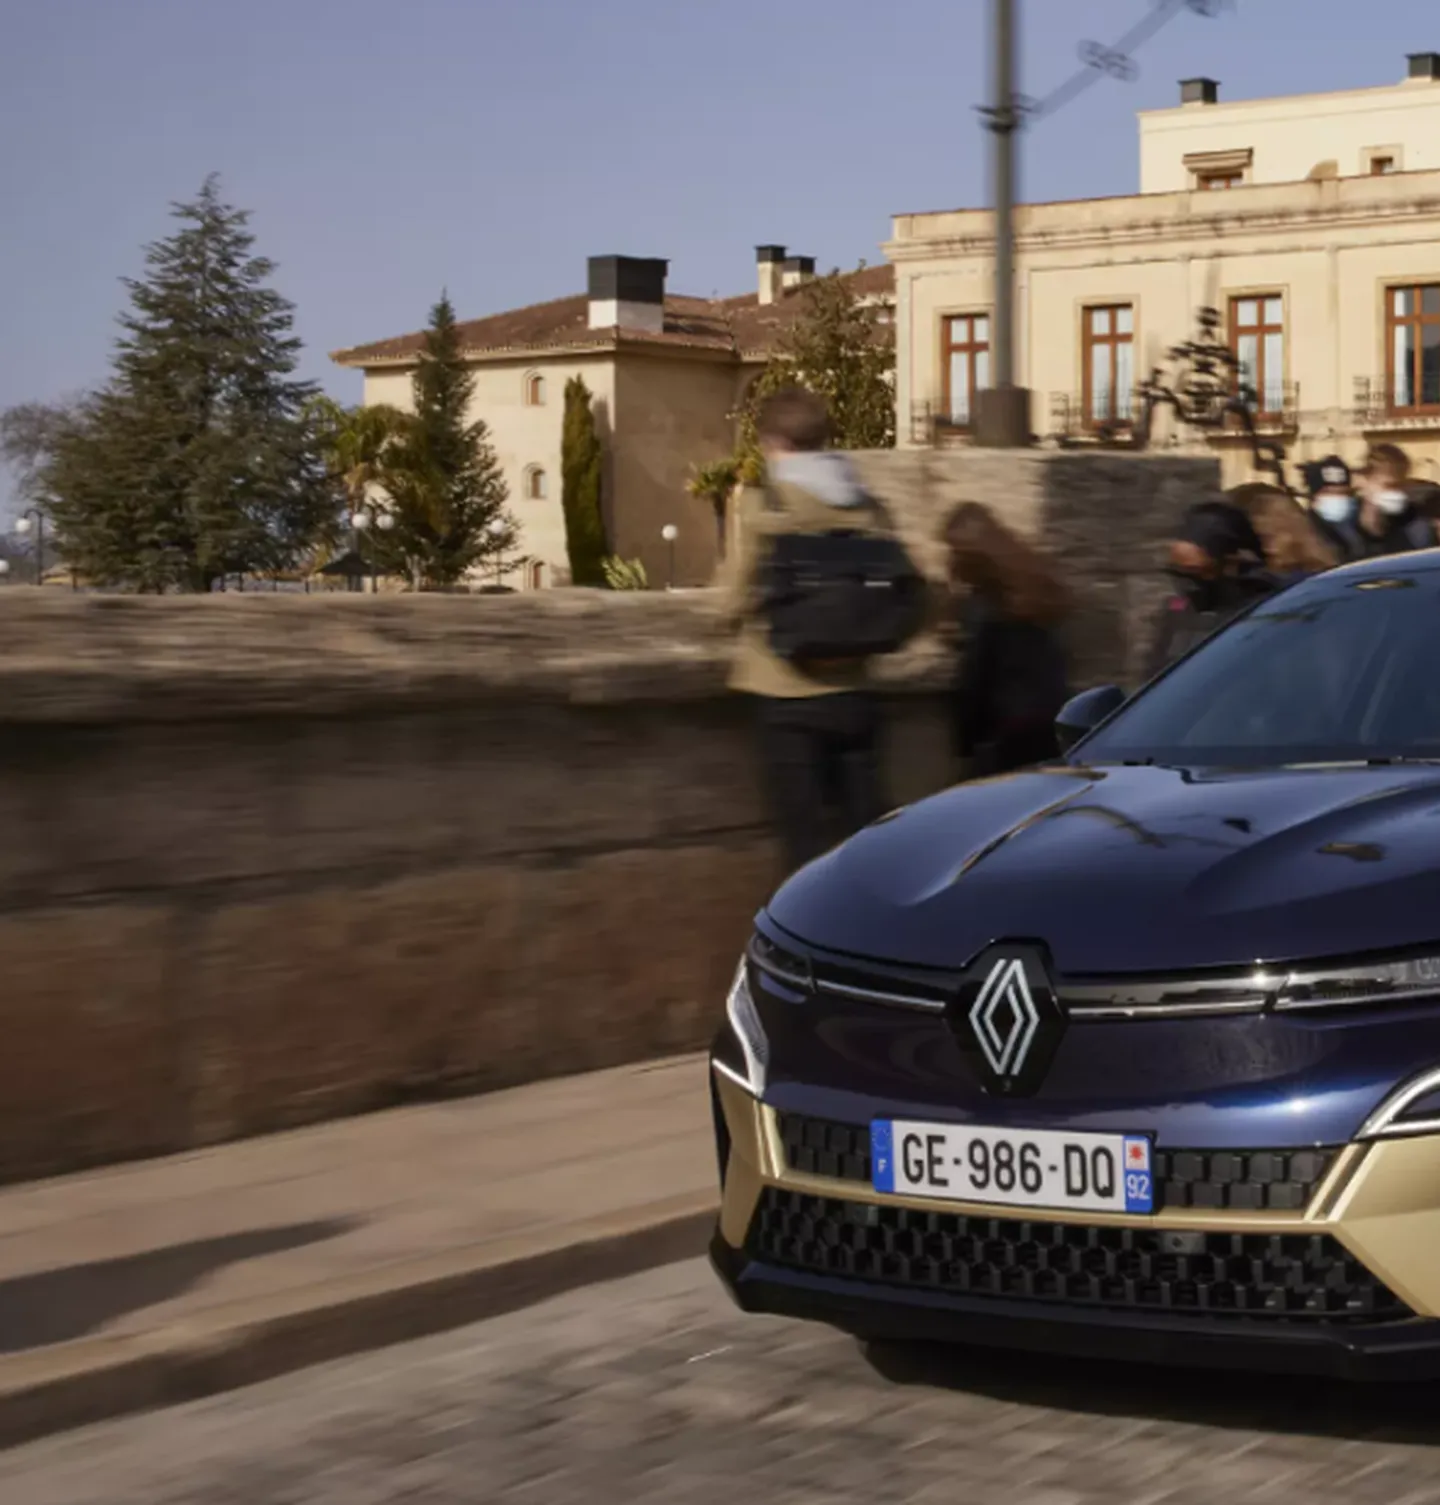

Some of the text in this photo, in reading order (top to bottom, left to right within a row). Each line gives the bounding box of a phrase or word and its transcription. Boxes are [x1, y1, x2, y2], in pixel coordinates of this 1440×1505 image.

[877, 1158, 887, 1174] F
[902, 1133, 1115, 1199] GE-986-DQ
[1126, 1173, 1150, 1200] 92
